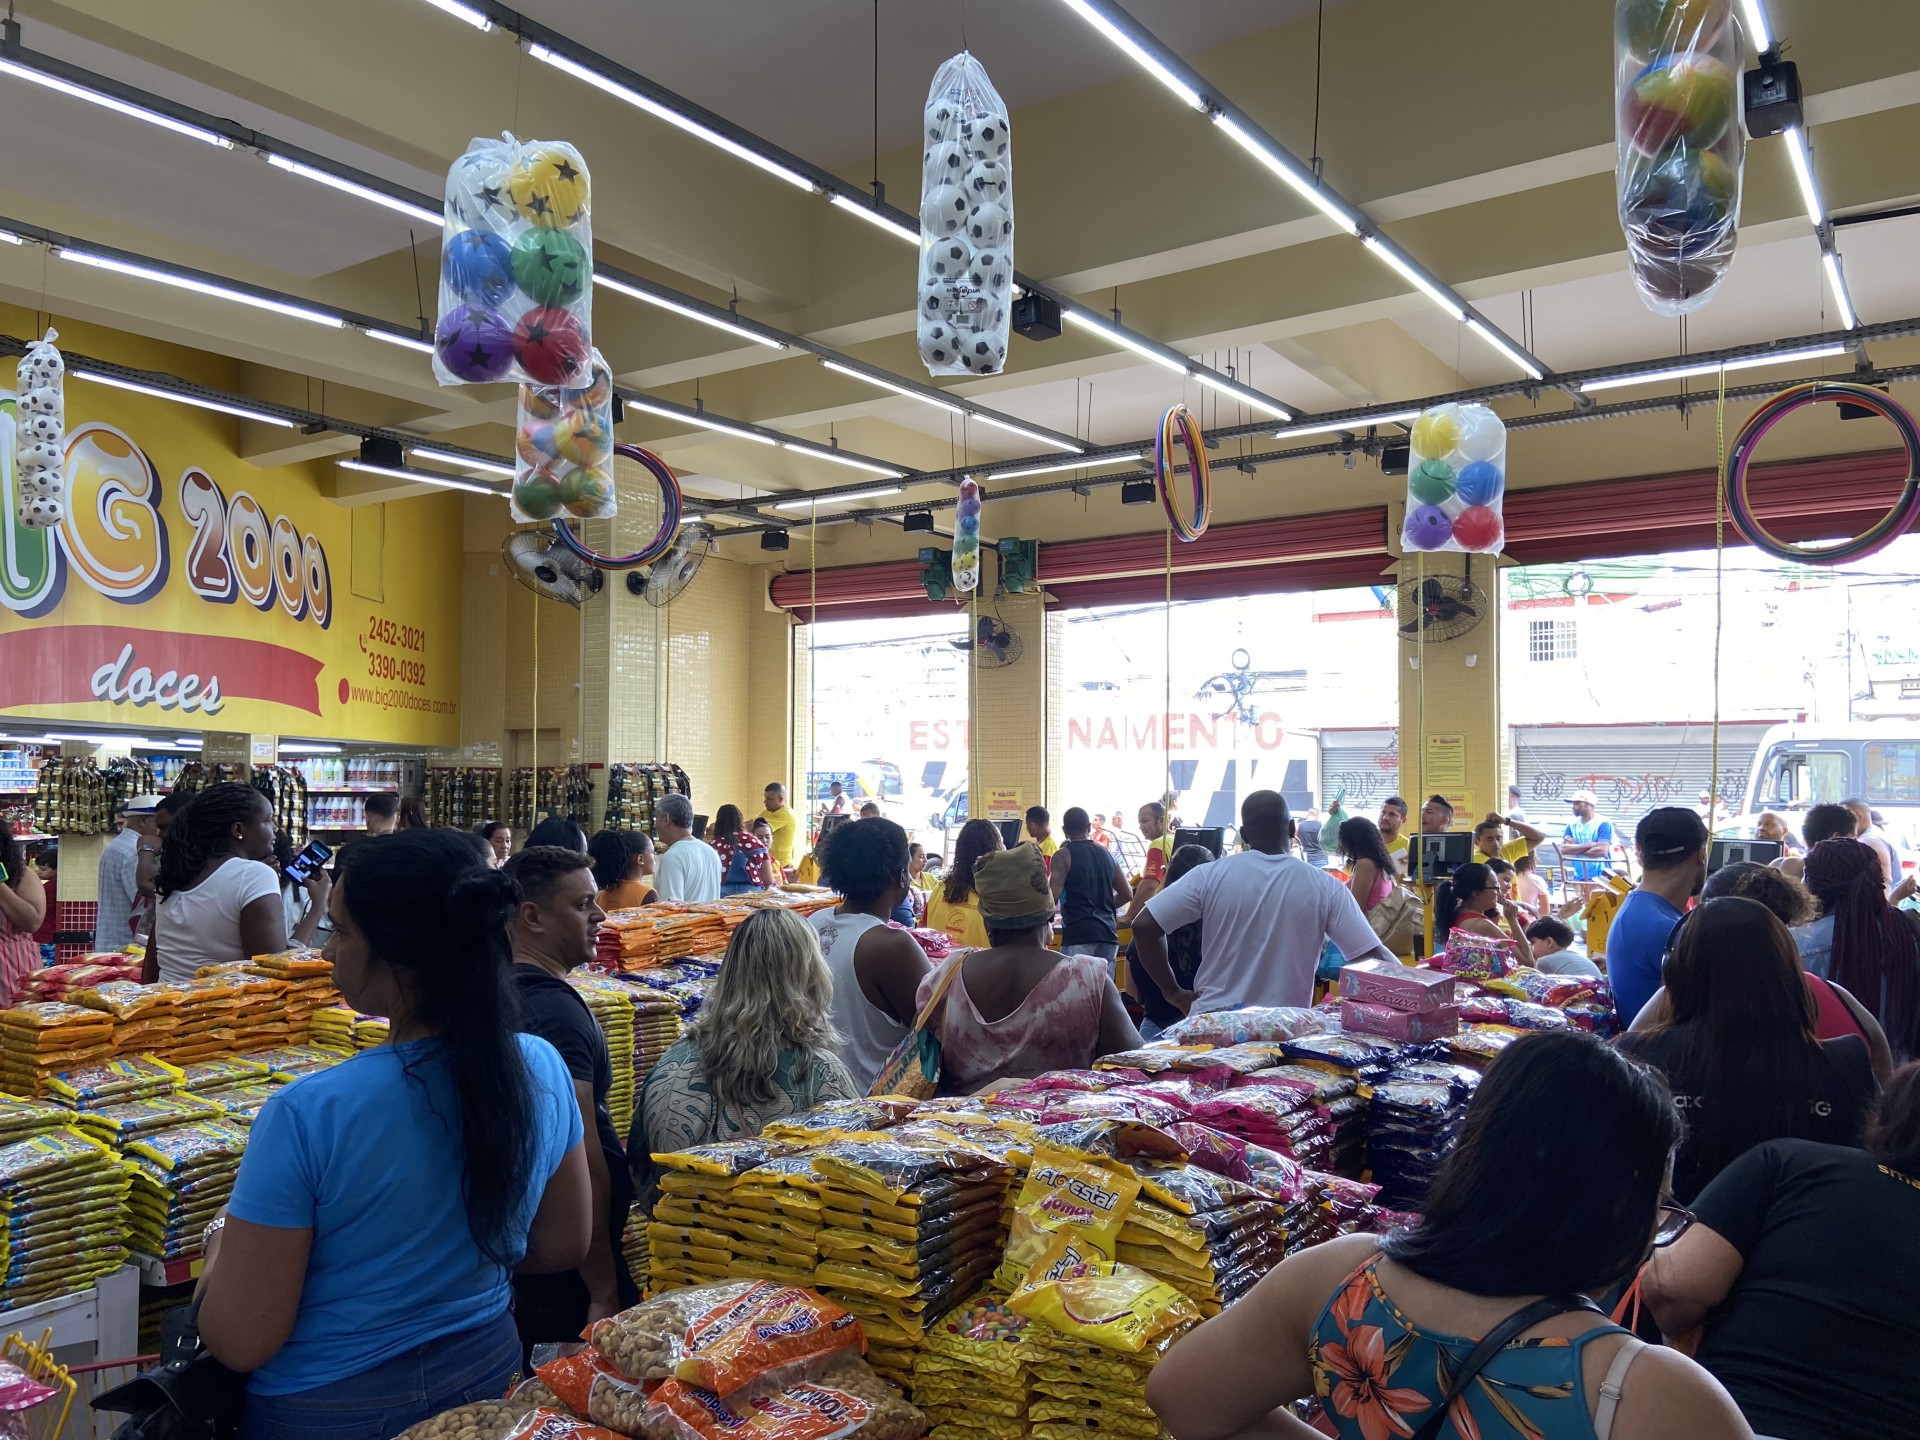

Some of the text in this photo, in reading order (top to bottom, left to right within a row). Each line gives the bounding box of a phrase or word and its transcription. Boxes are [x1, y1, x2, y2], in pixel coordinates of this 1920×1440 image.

[178, 465, 333, 632] 2000
[368, 615, 426, 653] 2452-3021
[91, 642, 225, 714] doces
[368, 651, 426, 686] 3390-0392
[351, 685, 457, 716] www.big2000doces.com.br
[1365, 985, 1420, 1010] Kaxuxa
[1035, 1166, 1121, 1212] Florestal
